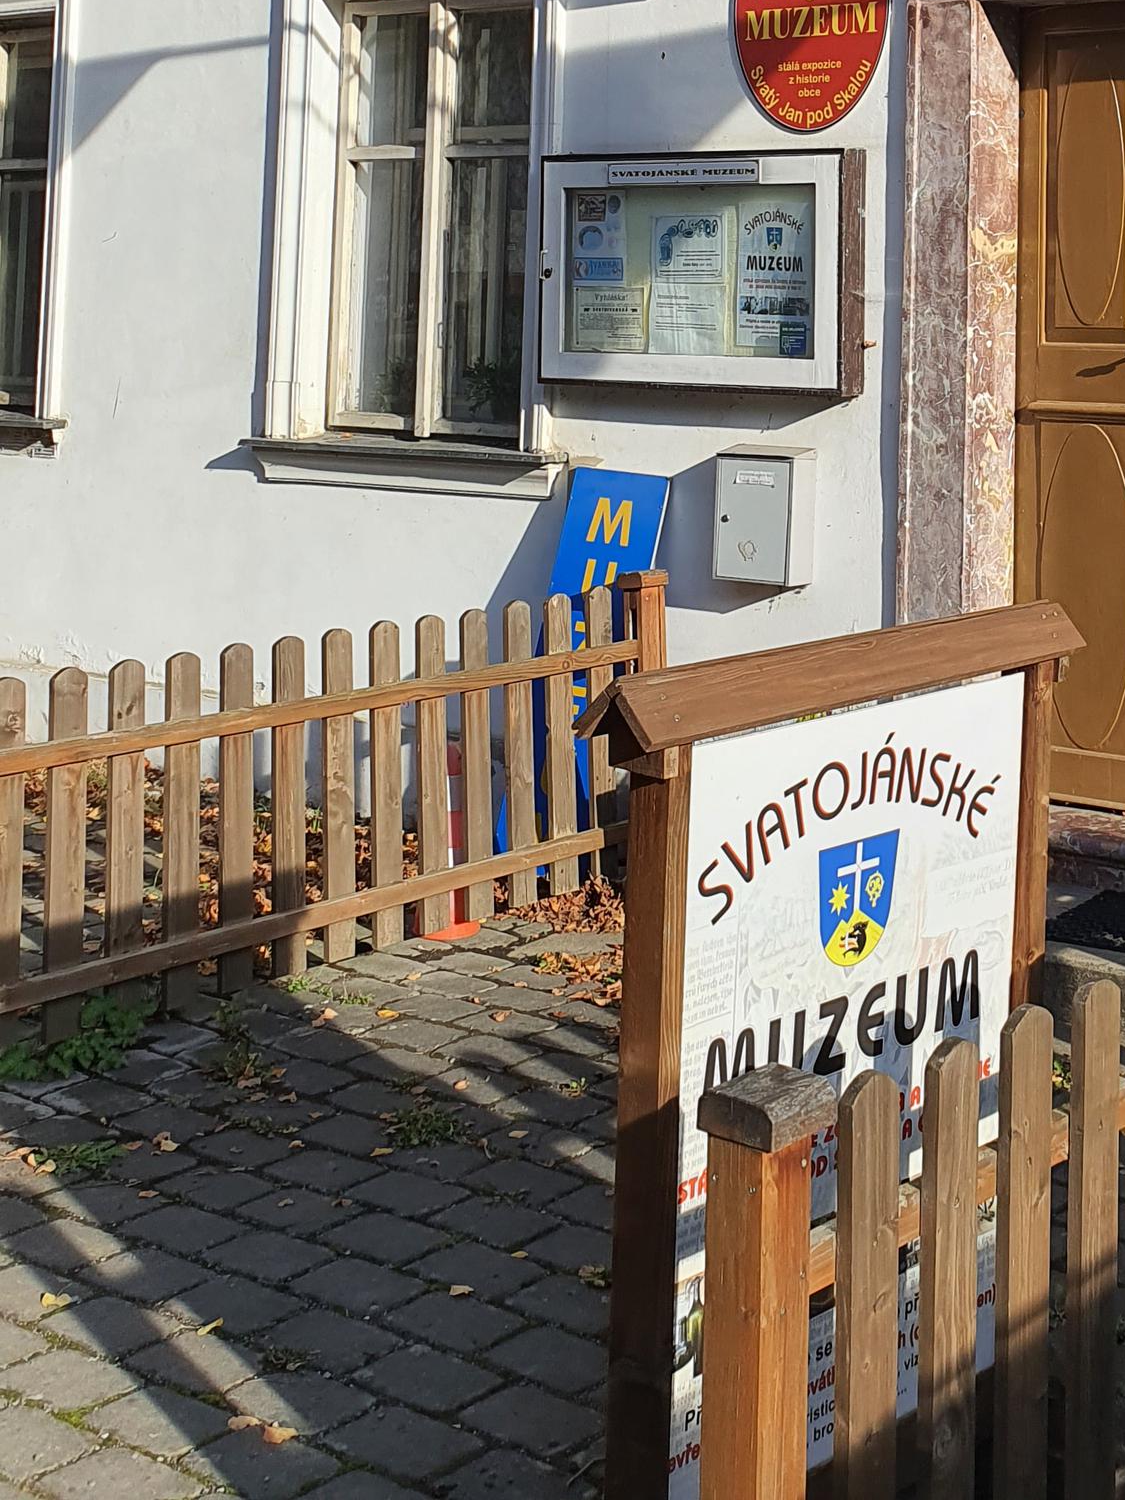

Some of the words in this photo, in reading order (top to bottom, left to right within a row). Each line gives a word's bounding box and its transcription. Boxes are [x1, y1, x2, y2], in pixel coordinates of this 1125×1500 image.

[744, 1, 878, 41] MUZEUM
[778, 60, 800, 71] stálá
[801, 59, 842, 72] expozice
[789, 76, 795, 84] z
[796, 73, 831, 84] historie
[751, 65, 780, 109] Svatý
[779, 100, 803, 124] Jan
[806, 105, 834, 128] pod
[834, 59, 872, 109] Skalou
[798, 87, 821, 97] obce
[611, 168, 698, 177] SVATOJÁNSKÉ
[702, 167, 756, 176] MUZEUM
[744, 208, 804, 235] SVATOJÁNSKÉ
[746, 255, 803, 273] MUZEUM
[698, 732, 1003, 924] SVATOJÁNSKÉ
